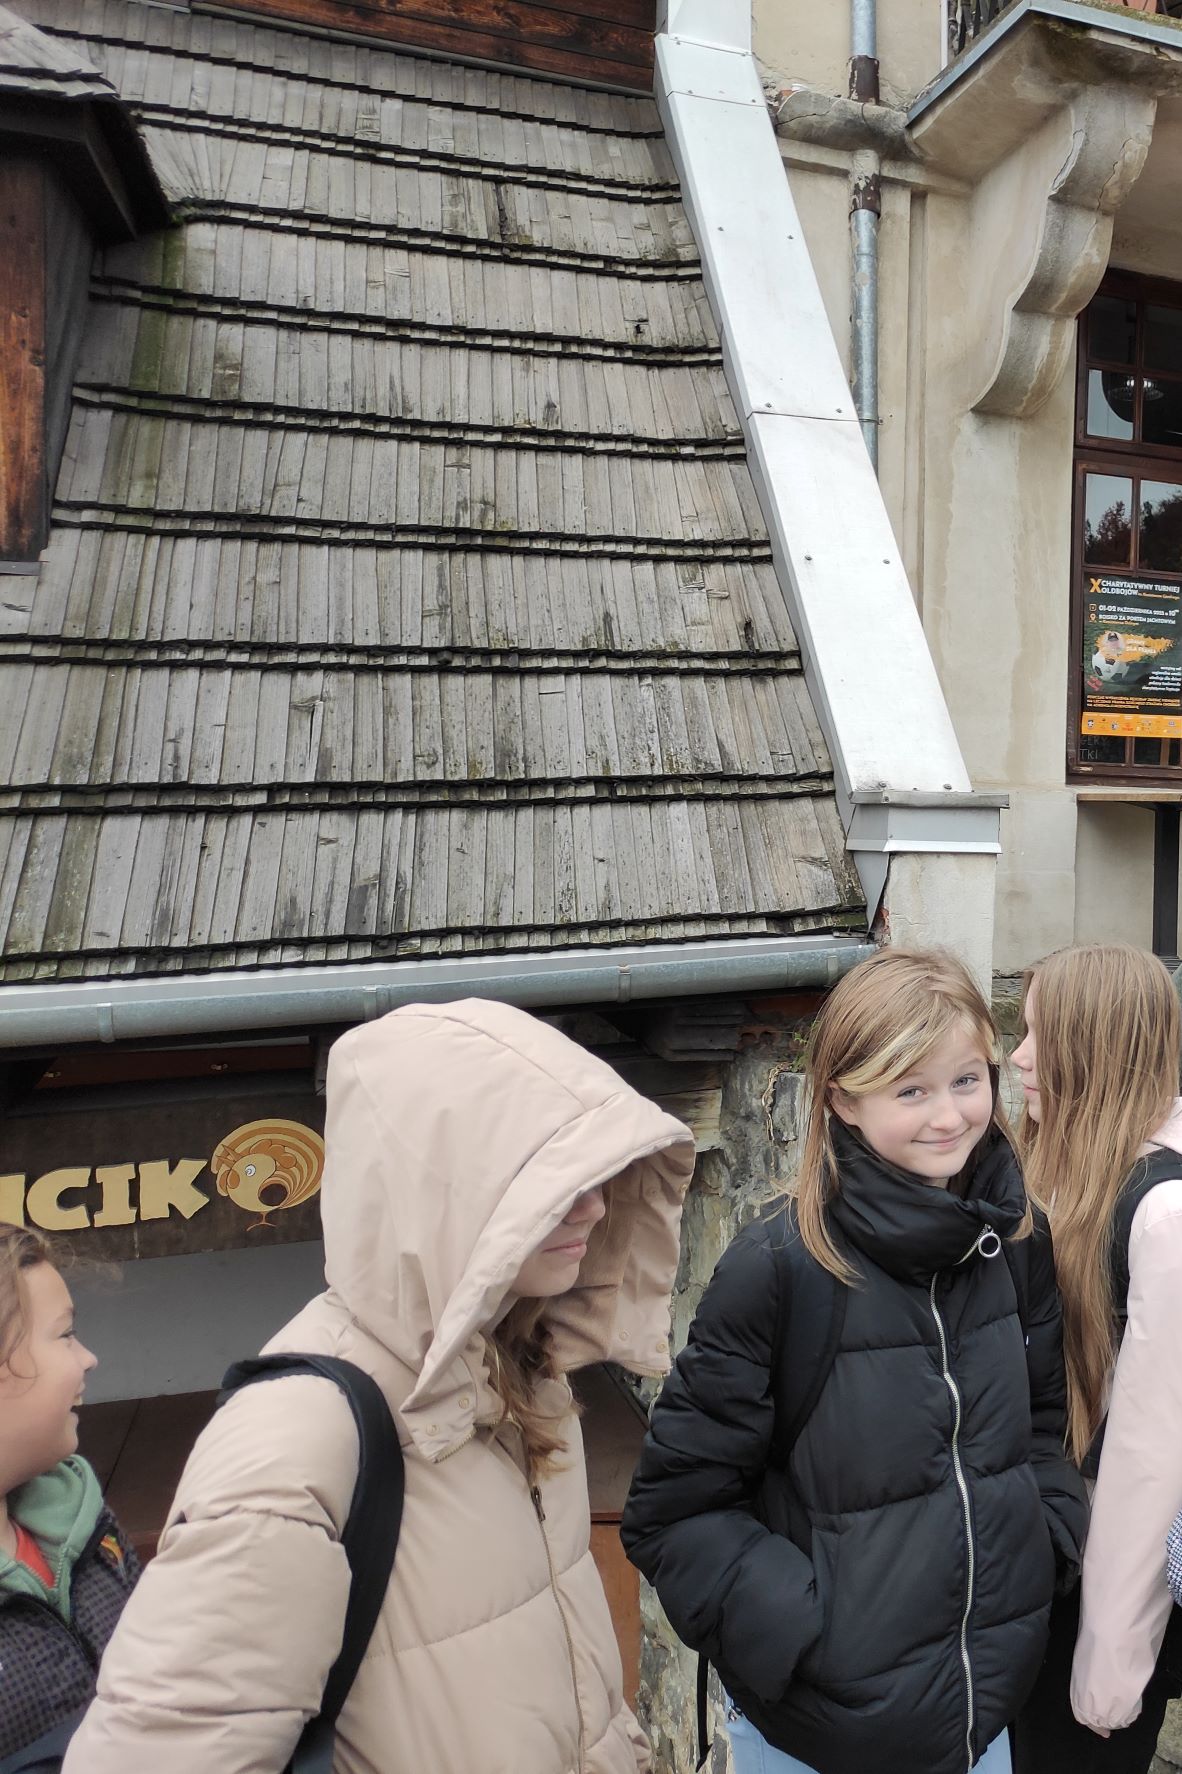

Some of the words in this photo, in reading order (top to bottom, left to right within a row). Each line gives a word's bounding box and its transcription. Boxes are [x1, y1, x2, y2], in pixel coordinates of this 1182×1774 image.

[1089, 578, 1103, 594] X
[1101, 579, 1154, 592] CHARYTATYWNY
[1154, 583, 1181, 594] TURNIEJ
[1101, 587, 1139, 596] OLDBOJÓW
